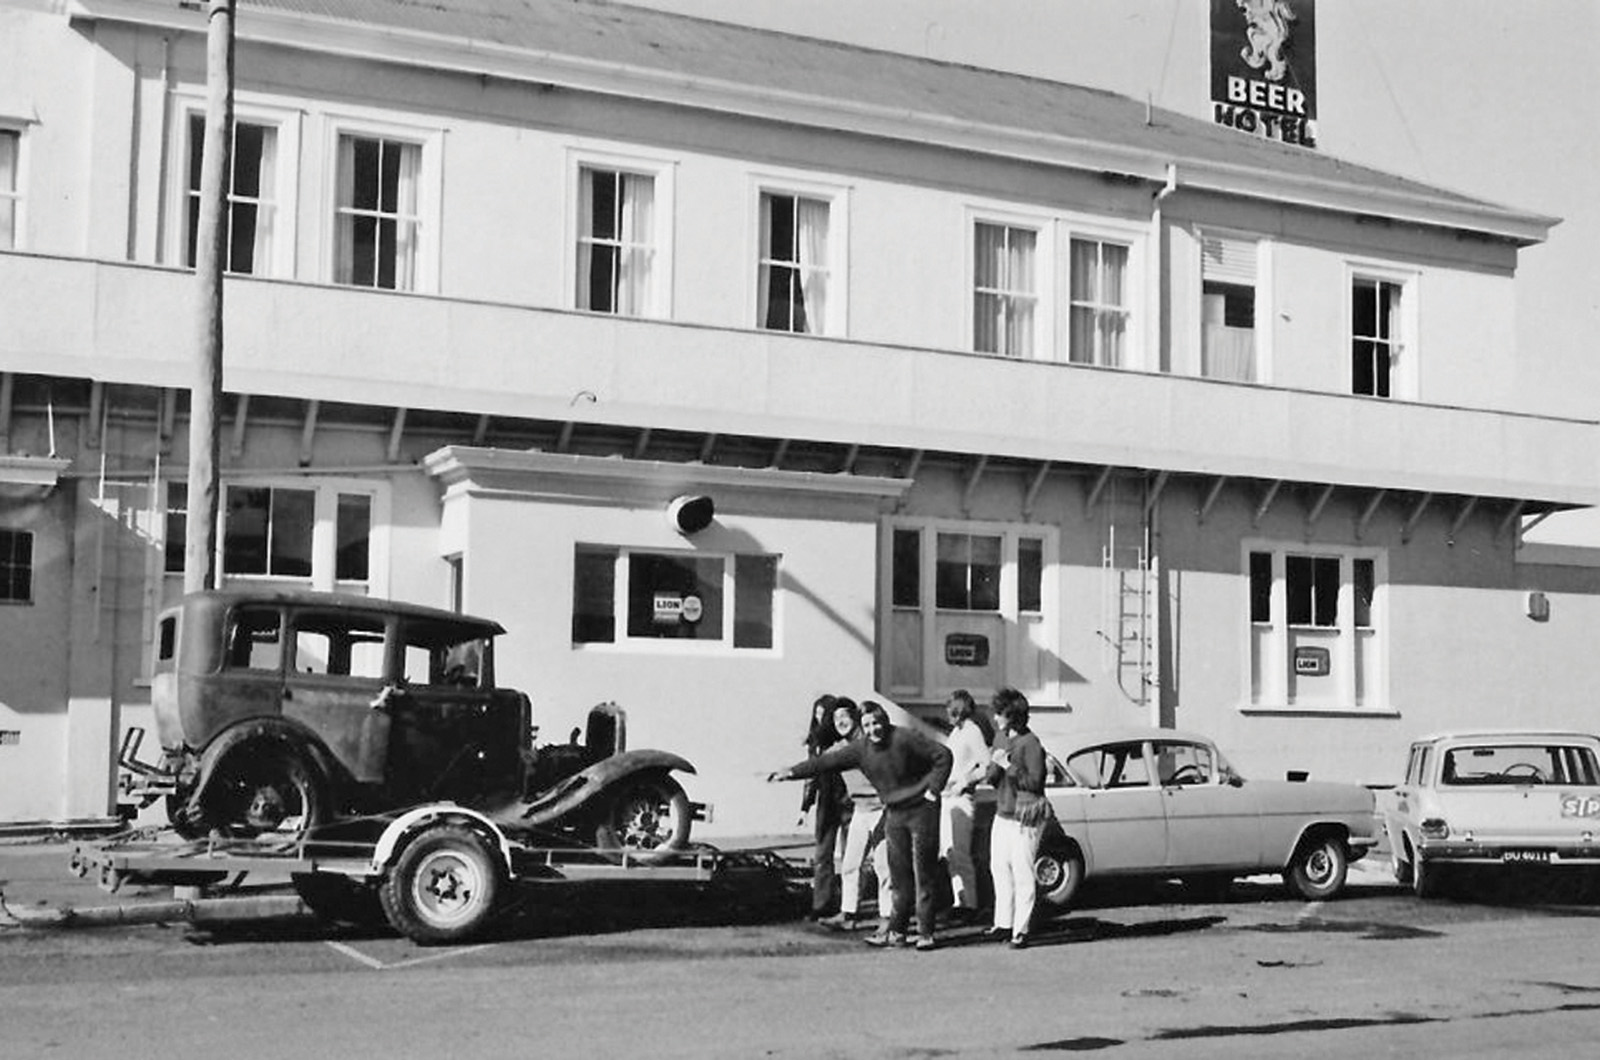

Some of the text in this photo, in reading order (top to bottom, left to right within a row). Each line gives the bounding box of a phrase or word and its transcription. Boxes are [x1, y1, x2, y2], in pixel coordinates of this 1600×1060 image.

[1228, 76, 1305, 114] BEER
[1214, 103, 1316, 148] HOTEL
[656, 600, 680, 609] LION
[1565, 796, 1600, 816] STP
